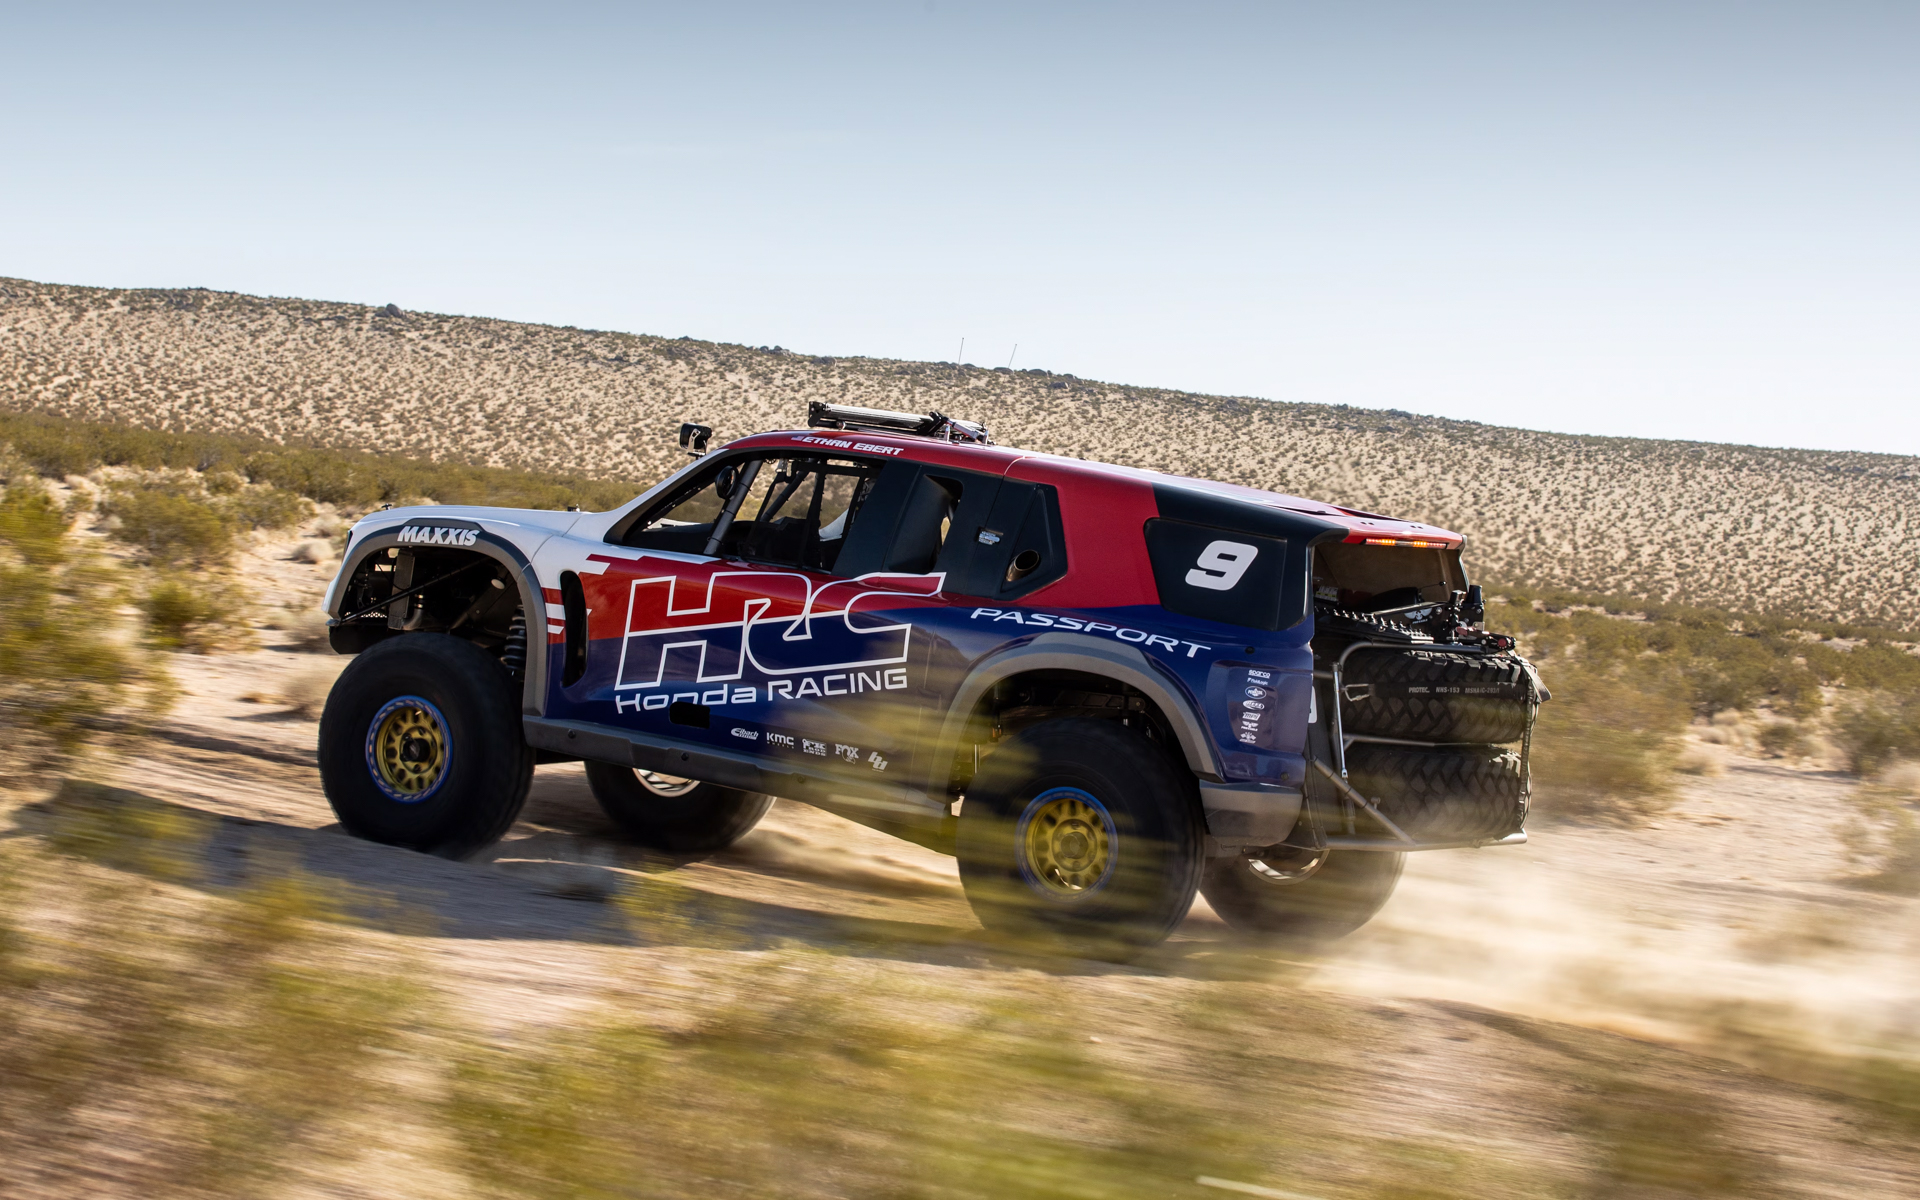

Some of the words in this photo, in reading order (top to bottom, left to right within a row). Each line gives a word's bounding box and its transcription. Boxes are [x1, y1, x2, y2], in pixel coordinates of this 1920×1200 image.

[802, 436, 852, 449] ETHAN
[852, 443, 904, 456] EBERT
[397, 525, 480, 547] MAXXIS
[1185, 540, 1258, 591] 9
[614, 572, 946, 690] HRC
[970, 607, 1211, 659] PASSPORT
[615, 684, 757, 714] Honda
[767, 667, 908, 702] RACING
[835, 743, 860, 761] FOX
